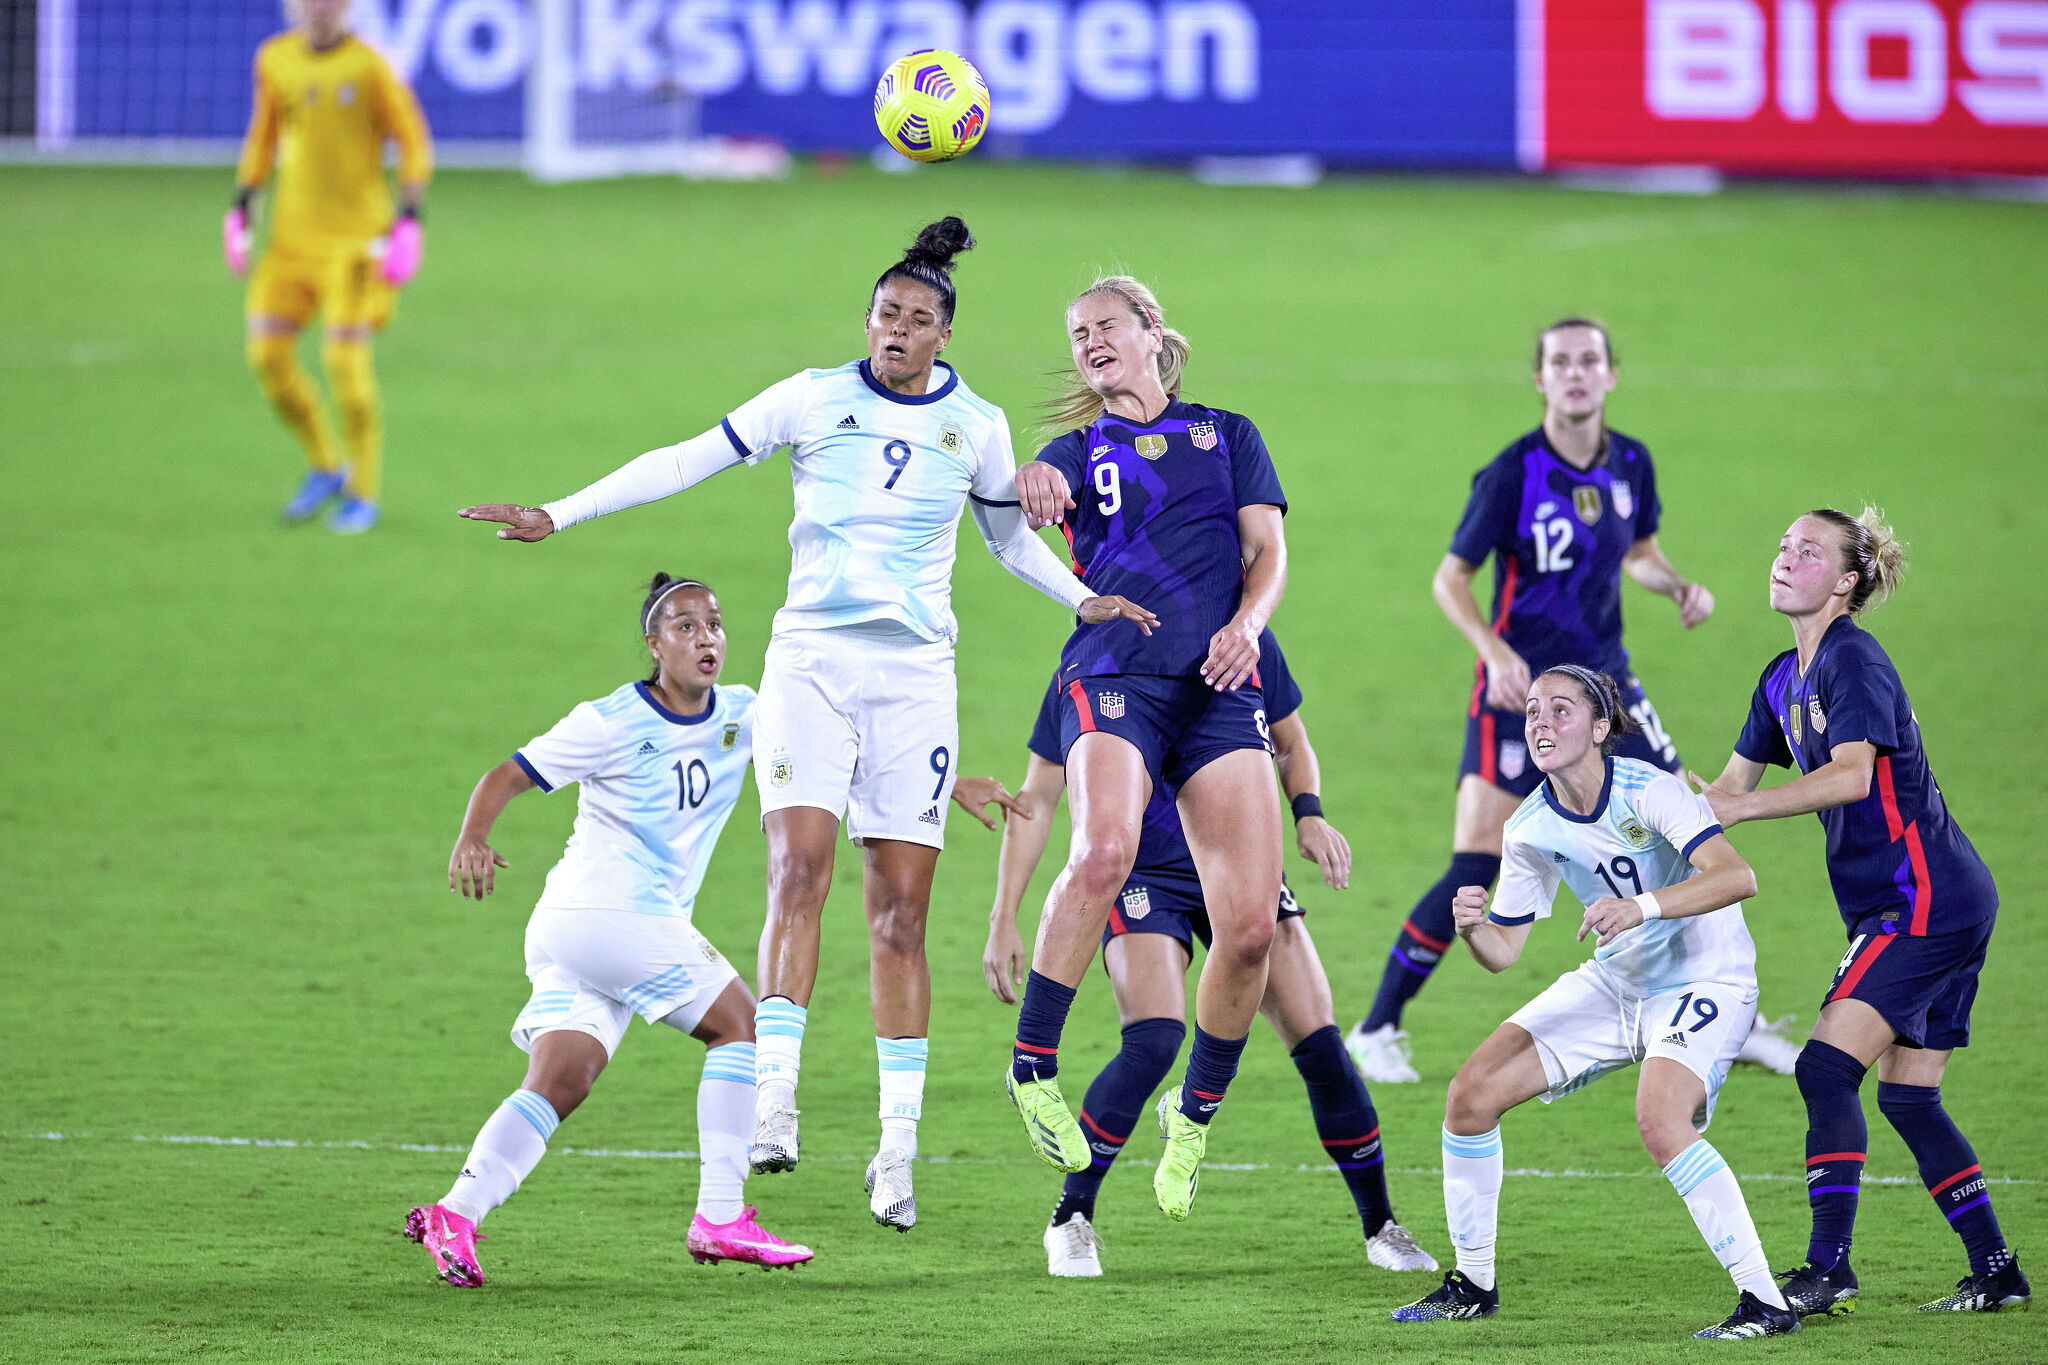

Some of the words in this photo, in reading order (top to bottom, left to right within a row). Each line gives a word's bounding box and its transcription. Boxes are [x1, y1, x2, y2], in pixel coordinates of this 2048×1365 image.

[345, 0, 1258, 131] Vokswagen
[1190, 427, 1213, 436] USA
[883, 440, 911, 490] 9
[1094, 462, 1121, 516] 9
[1531, 517, 1574, 573] 12
[1101, 697, 1123, 706] USA
[672, 759, 710, 811] 10
[930, 746, 949, 800] 9
[919, 816, 941, 826] adidas
[1594, 856, 1643, 898] 19
[1126, 894, 1146, 905] USA
[1838, 934, 1867, 976] 4
[1669, 992, 1719, 1032] 19
[1661, 1038, 1688, 1048] adidas
